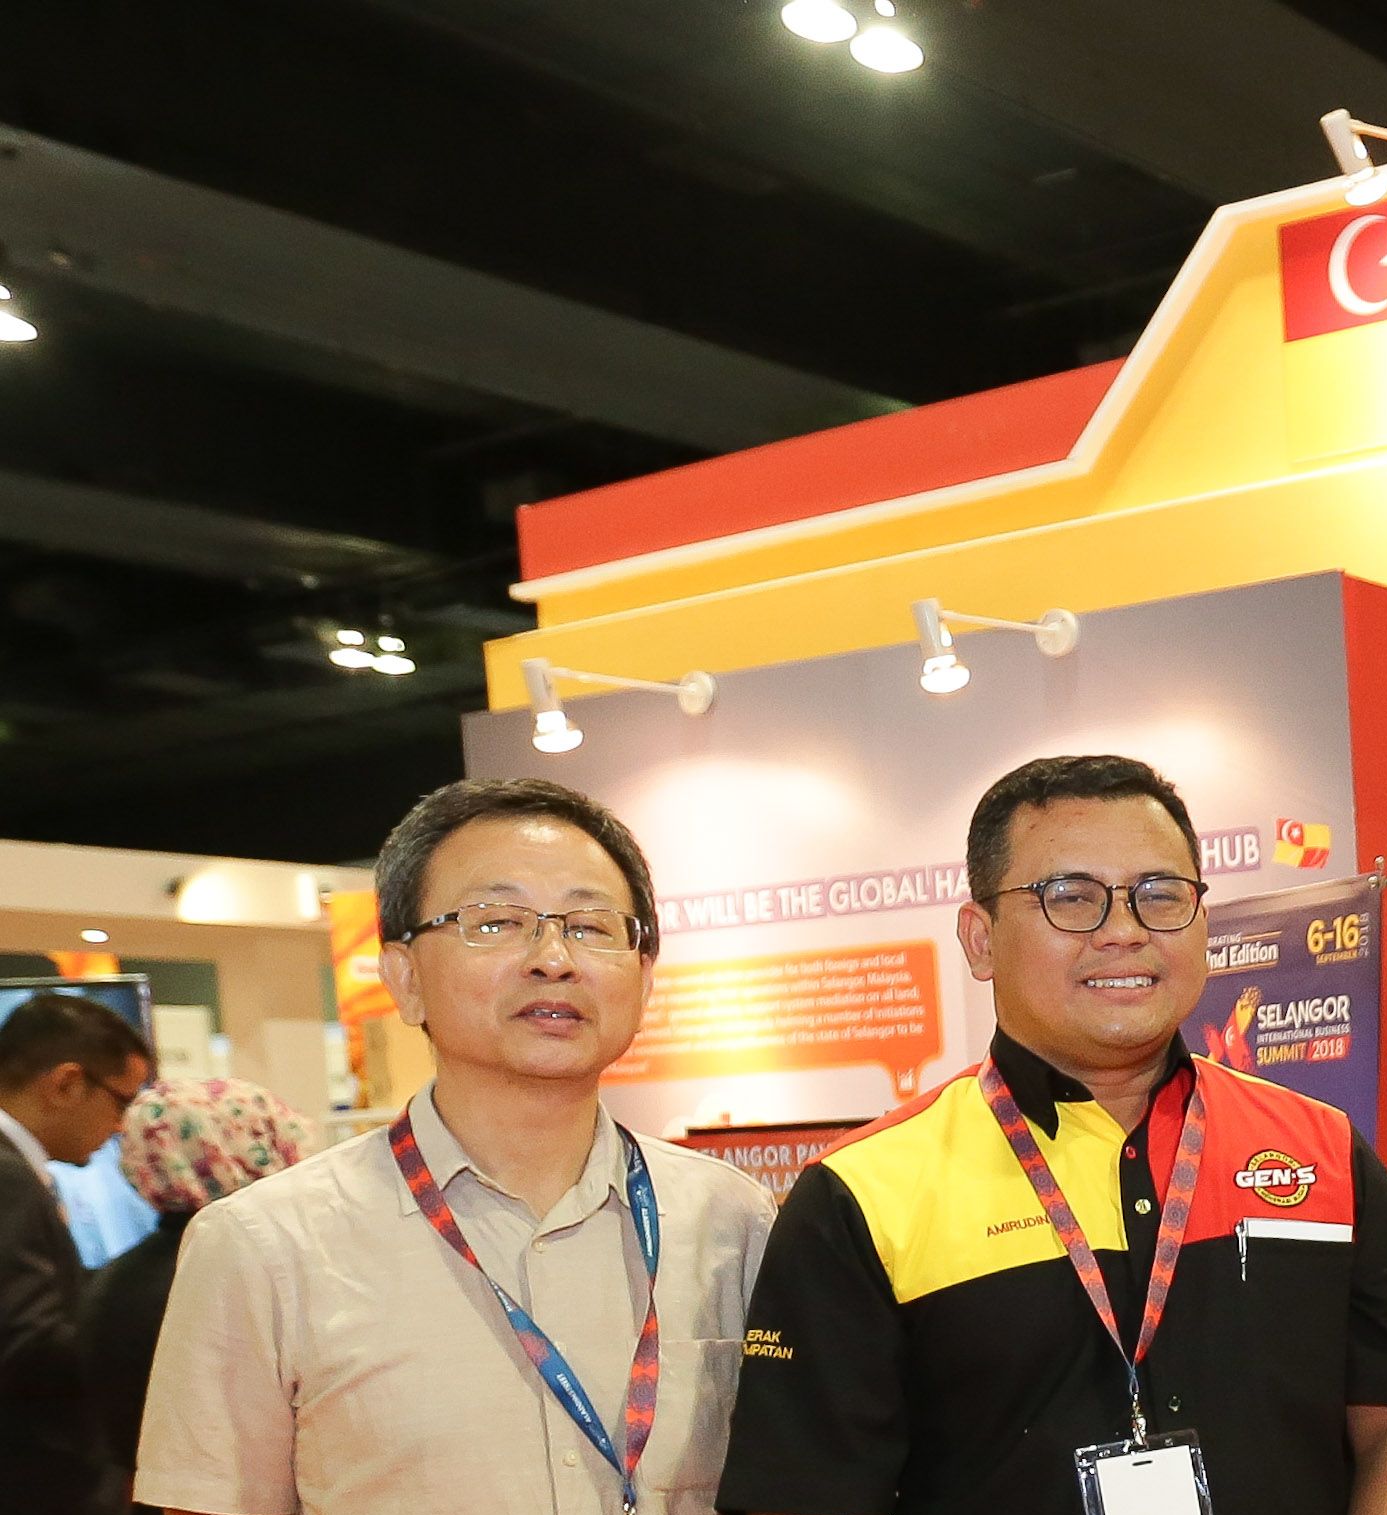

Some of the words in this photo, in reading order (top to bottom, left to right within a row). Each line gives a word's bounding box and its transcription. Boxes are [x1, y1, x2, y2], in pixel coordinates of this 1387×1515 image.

[683, 893, 740, 926] WILL
[742, 889, 773, 924] BE
[777, 882, 825, 918] THE
[828, 869, 928, 911] GLOBAL
[935, 866, 971, 899] HA
[1200, 833, 1261, 871] HUB
[1306, 912, 1361, 955] 6-16
[860, 954, 880, 969] and
[881, 950, 907, 967] local
[1228, 940, 1280, 967] Edition
[1256, 994, 1351, 1030] SELANGOR
[1256, 1028, 1314, 1045] INTERNATIONAL
[1314, 1022, 1350, 1038] BUSINESS
[1256, 1041, 1307, 1067] SUMMIT
[1311, 1037, 1346, 1059] 2018
[986, 1213, 1051, 1238] AMIRUDIN
[747, 1329, 782, 1343] ERAK
[742, 1343, 794, 1360] MPATAN
